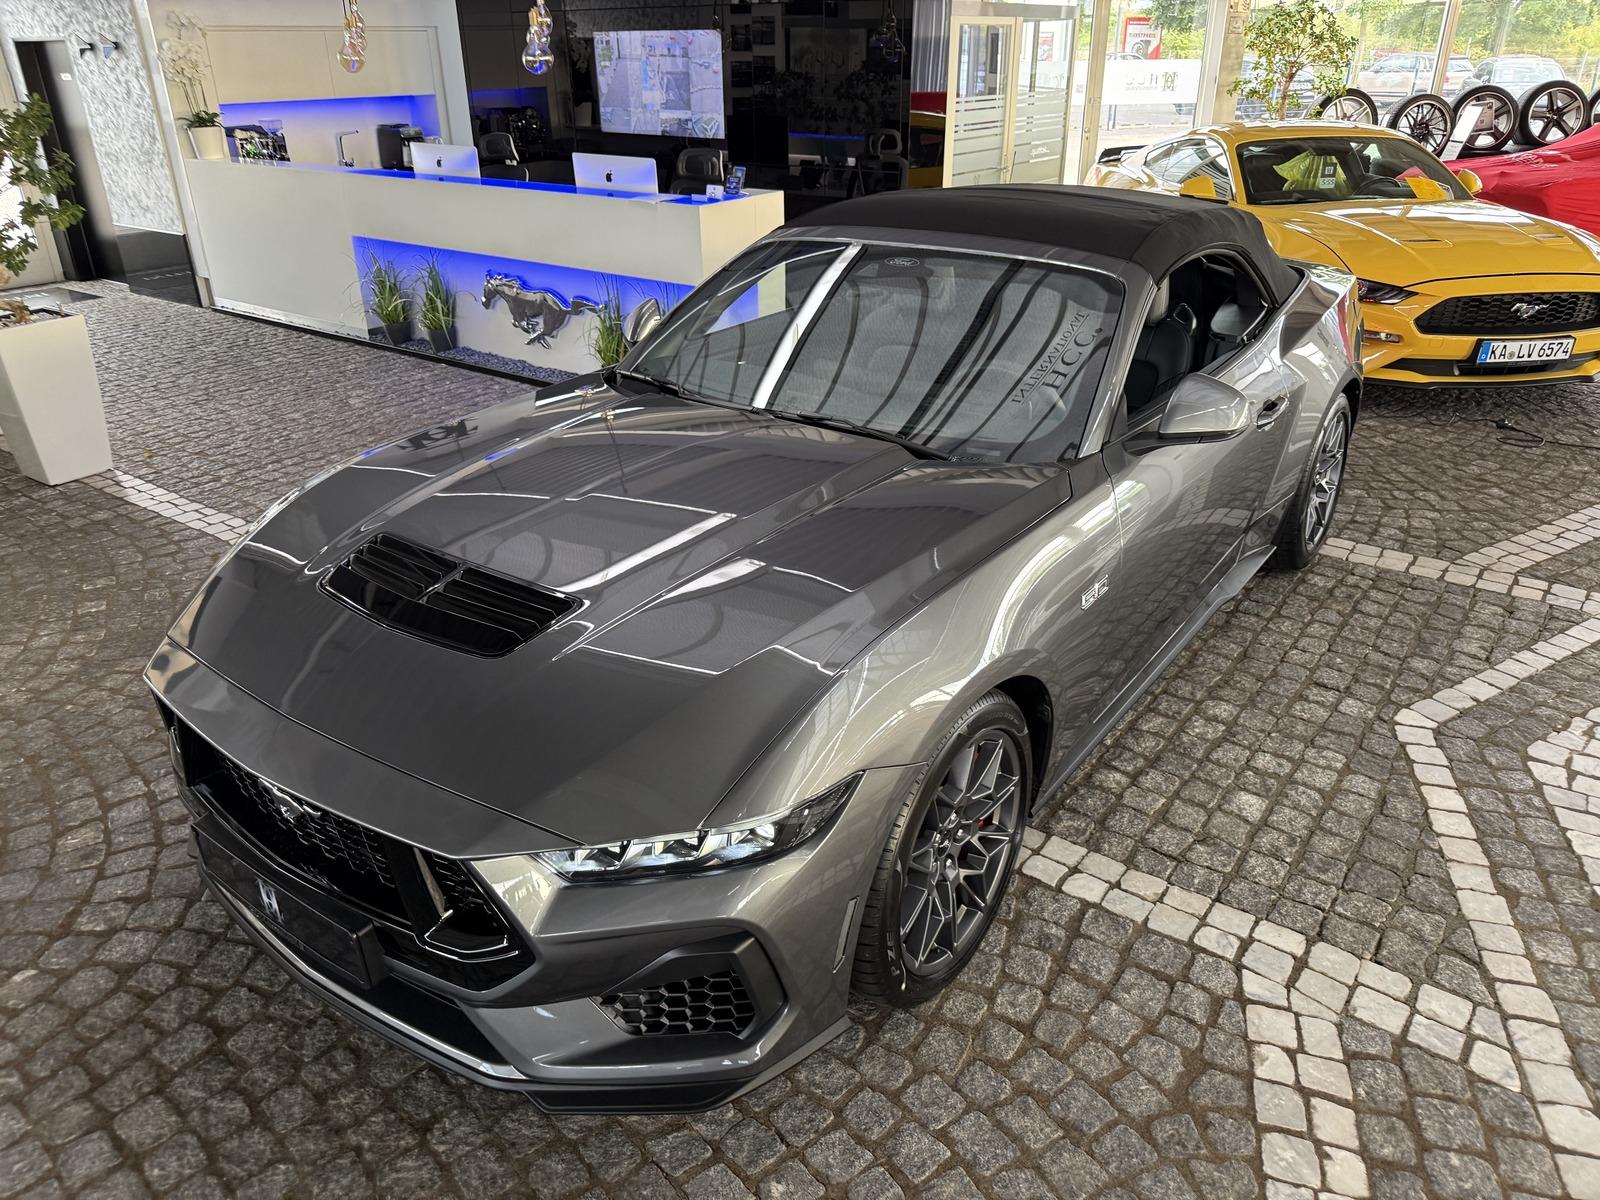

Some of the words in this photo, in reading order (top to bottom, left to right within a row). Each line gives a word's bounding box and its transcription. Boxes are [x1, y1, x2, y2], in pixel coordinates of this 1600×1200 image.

[1489, 344, 1507, 360] KA
[1517, 343, 1536, 359] LV
[1537, 341, 1570, 357] 6574
